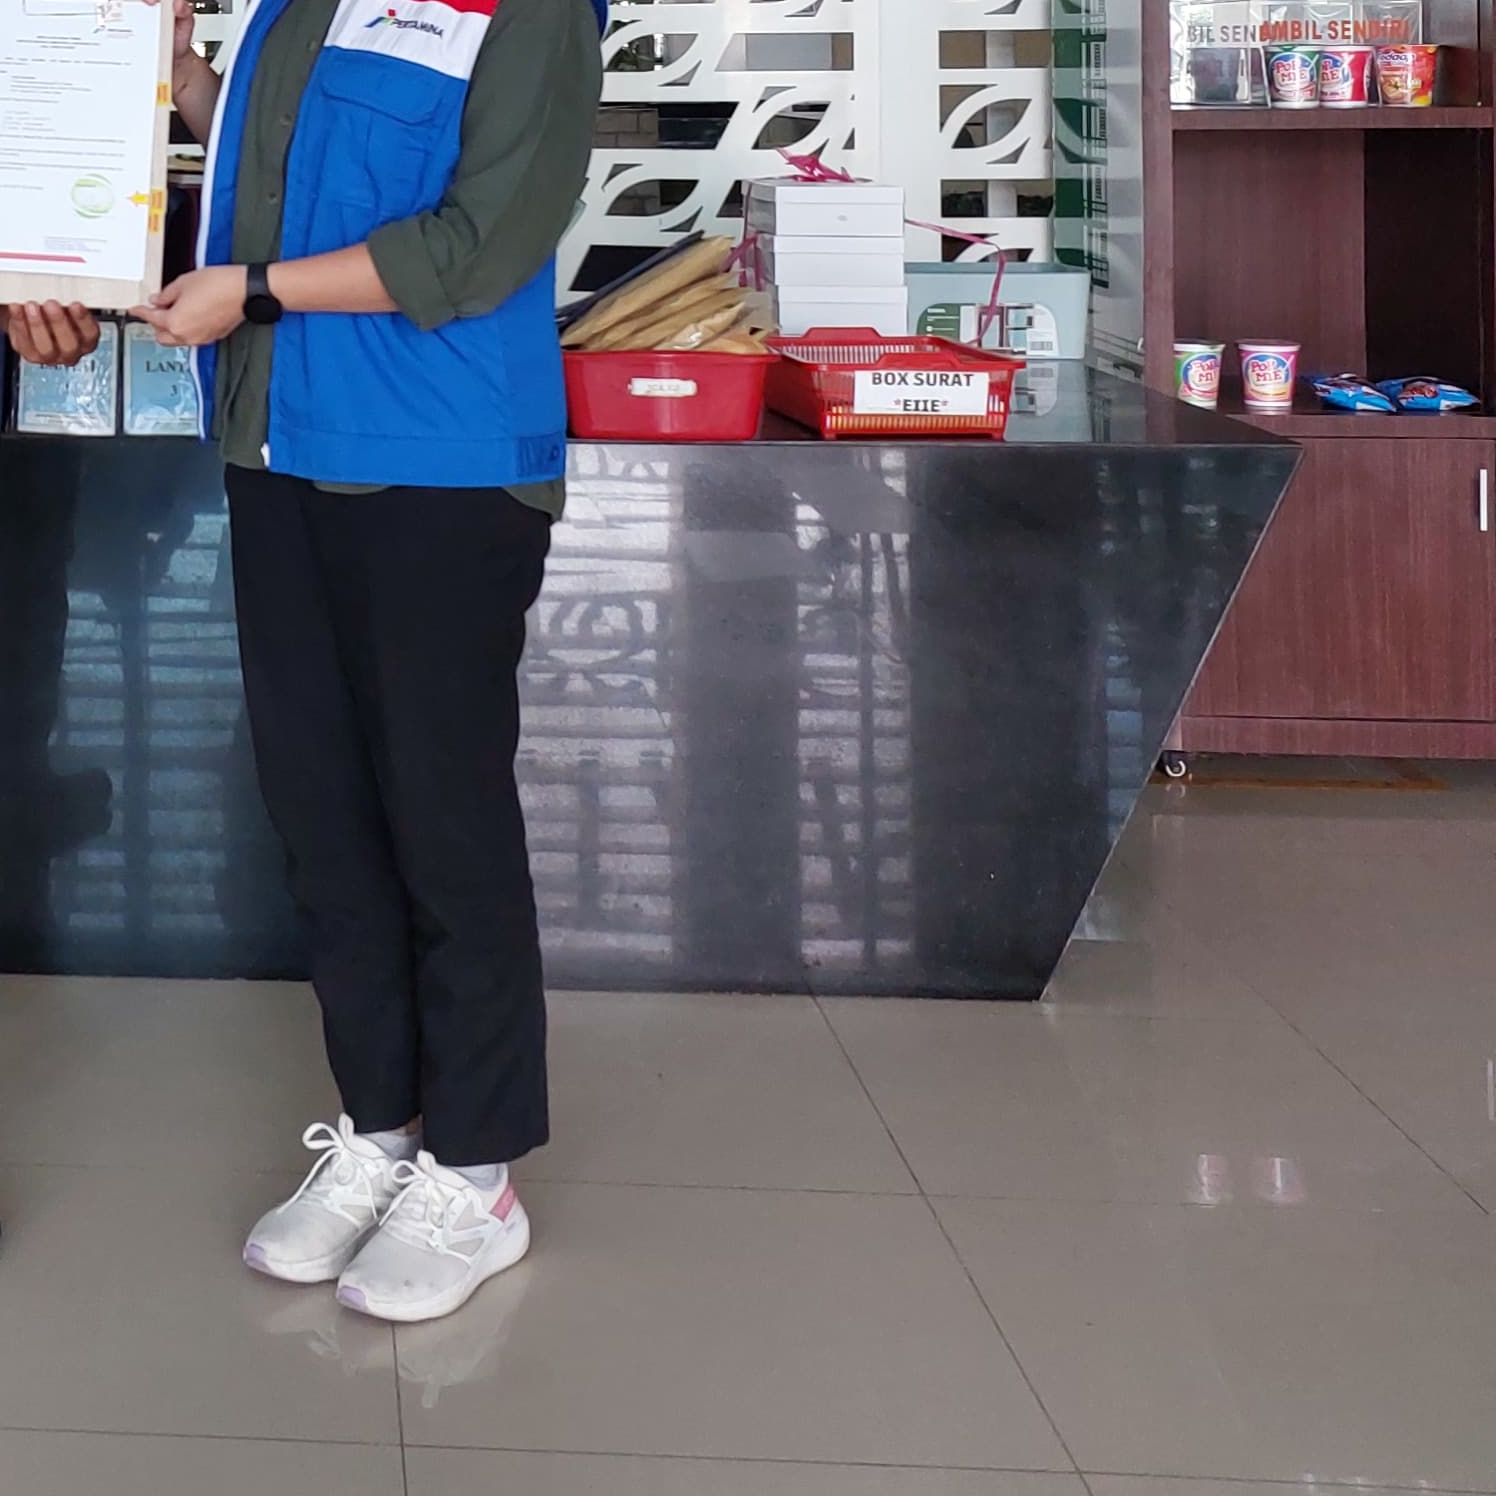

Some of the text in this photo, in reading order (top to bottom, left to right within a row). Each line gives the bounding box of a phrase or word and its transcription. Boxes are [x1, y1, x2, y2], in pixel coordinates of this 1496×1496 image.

[1259, 19, 1322, 41] AMBIL
[872, 373, 974, 387] BOX SURAT
